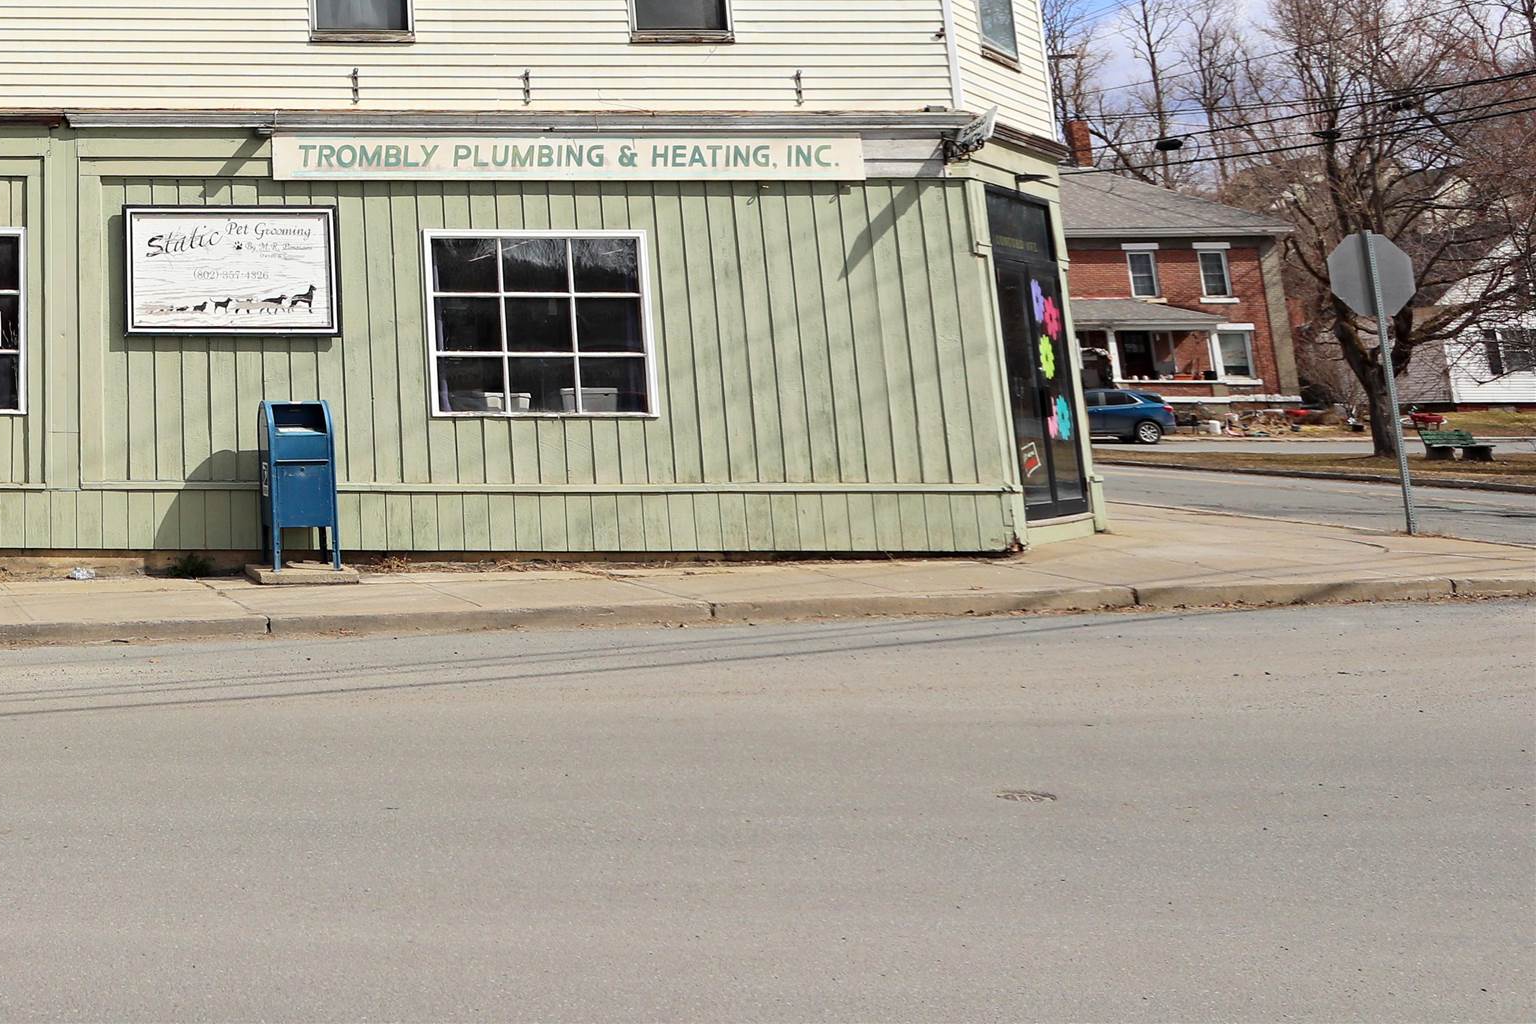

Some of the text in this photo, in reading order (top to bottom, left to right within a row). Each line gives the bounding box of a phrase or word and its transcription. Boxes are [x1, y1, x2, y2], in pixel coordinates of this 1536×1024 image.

[298, 144, 839, 169] TROMBLY PLUMBING & HEATING, INC.
[146, 225, 224, 258] Static
[225, 222, 311, 241] Pet Grooming
